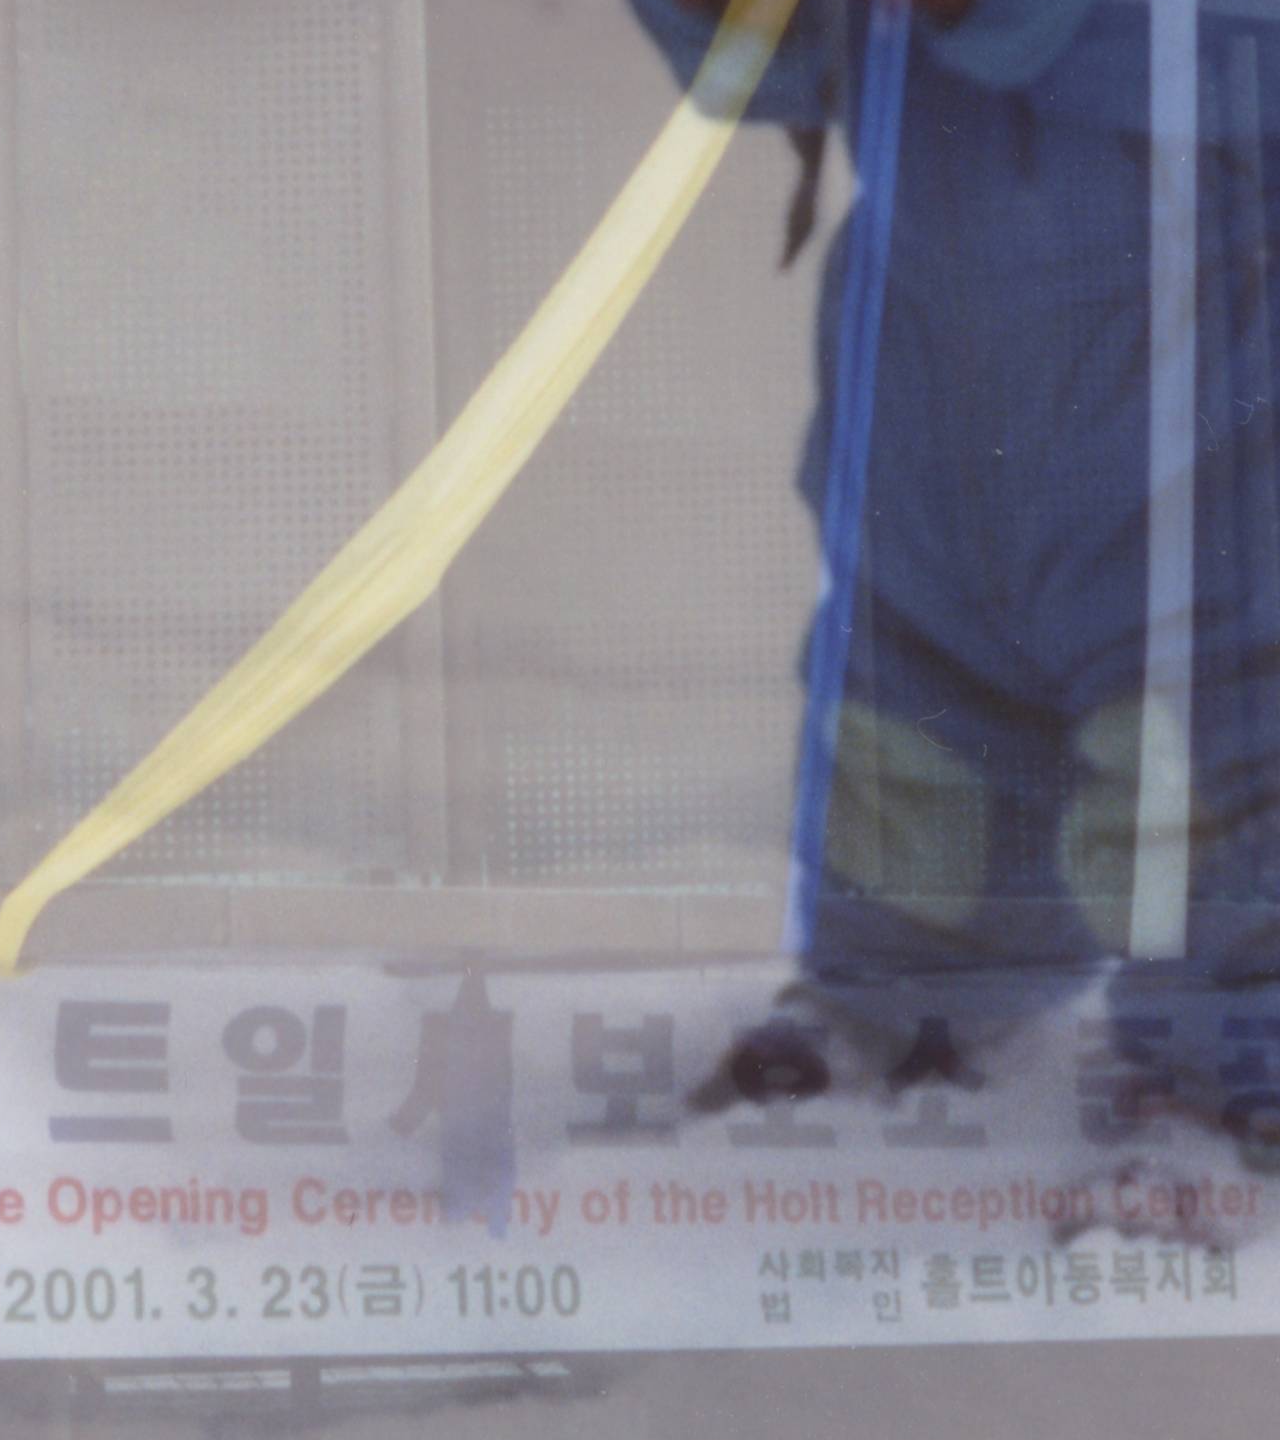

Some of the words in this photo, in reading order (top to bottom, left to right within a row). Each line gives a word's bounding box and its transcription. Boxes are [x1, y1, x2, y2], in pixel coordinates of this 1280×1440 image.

[47, 1176, 269, 1237] Opening
[292, 1176, 561, 1237] Cereny
[580, 1176, 632, 1224] of
[650, 1178, 729, 1224] the
[744, 1178, 840, 1224] Holt
[855, 1177, 1098, 1233] Reception
[1122, 1176, 1265, 1222] Center
[4, 1266, 162, 1322] 2001.
[186, 1265, 239, 1319] 3.
[447, 1263, 583, 1319] 11:00
[919, 1249, 1240, 1312] 홀트아동복지회
